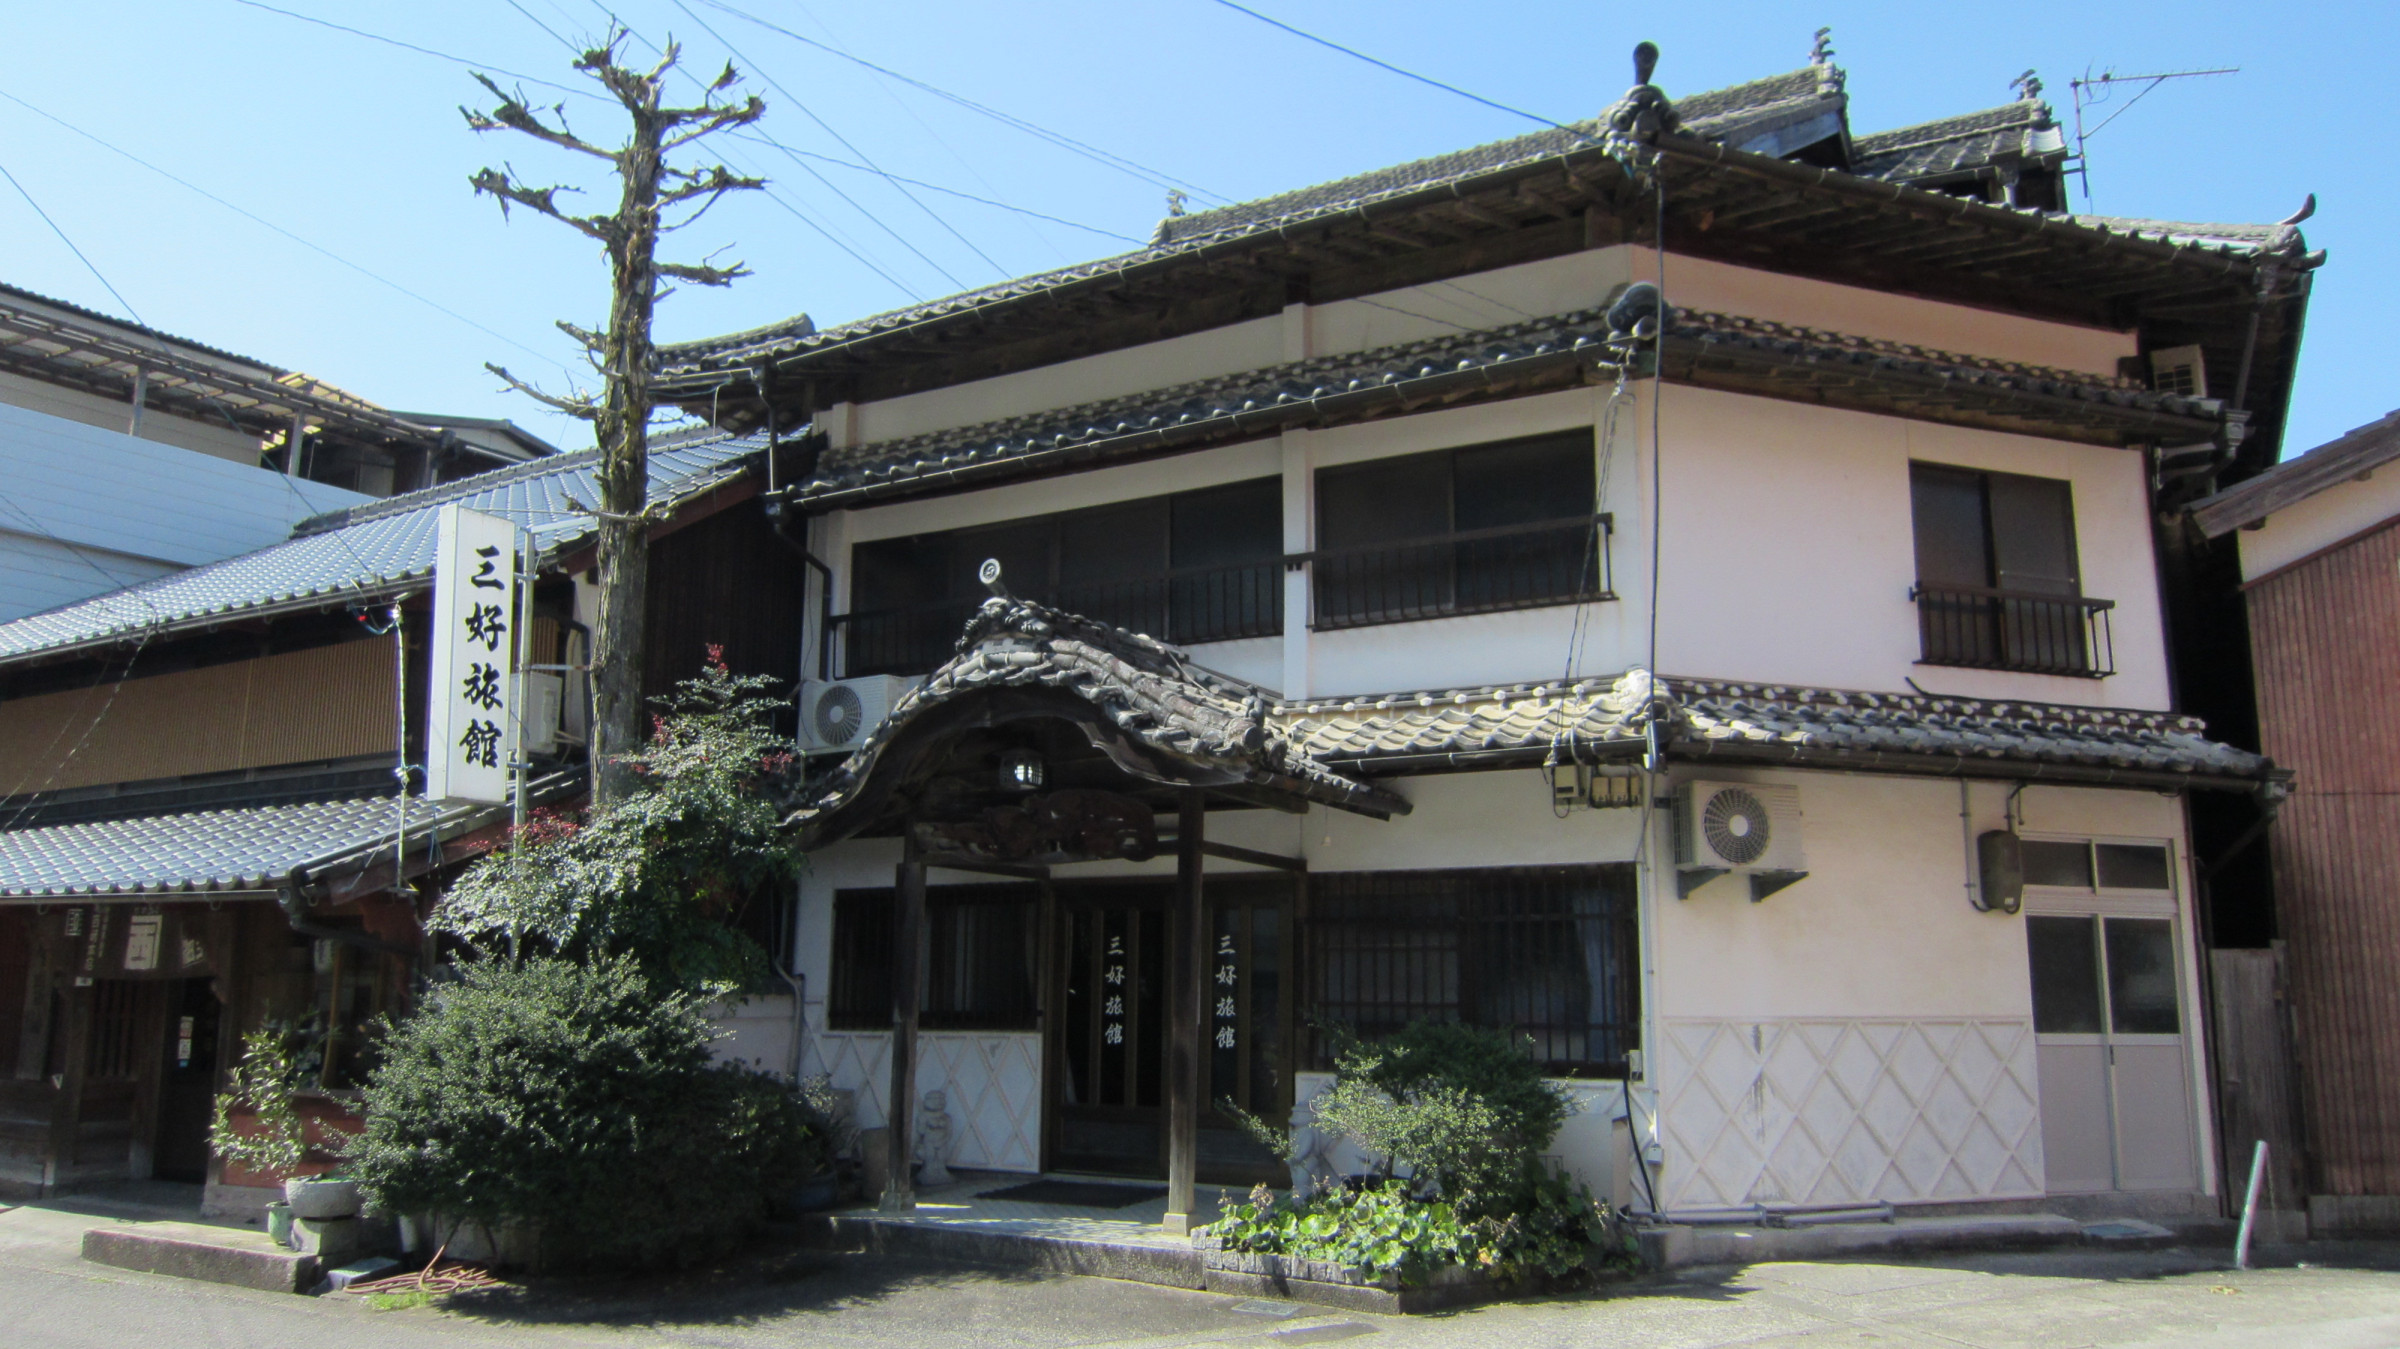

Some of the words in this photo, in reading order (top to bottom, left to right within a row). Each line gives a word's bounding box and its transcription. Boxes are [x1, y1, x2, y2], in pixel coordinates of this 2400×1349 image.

[459, 545, 507, 769] 三好旅館
[1105, 936, 1125, 1044] 三好旅館
[1216, 935, 1238, 1049] 三好旅館
